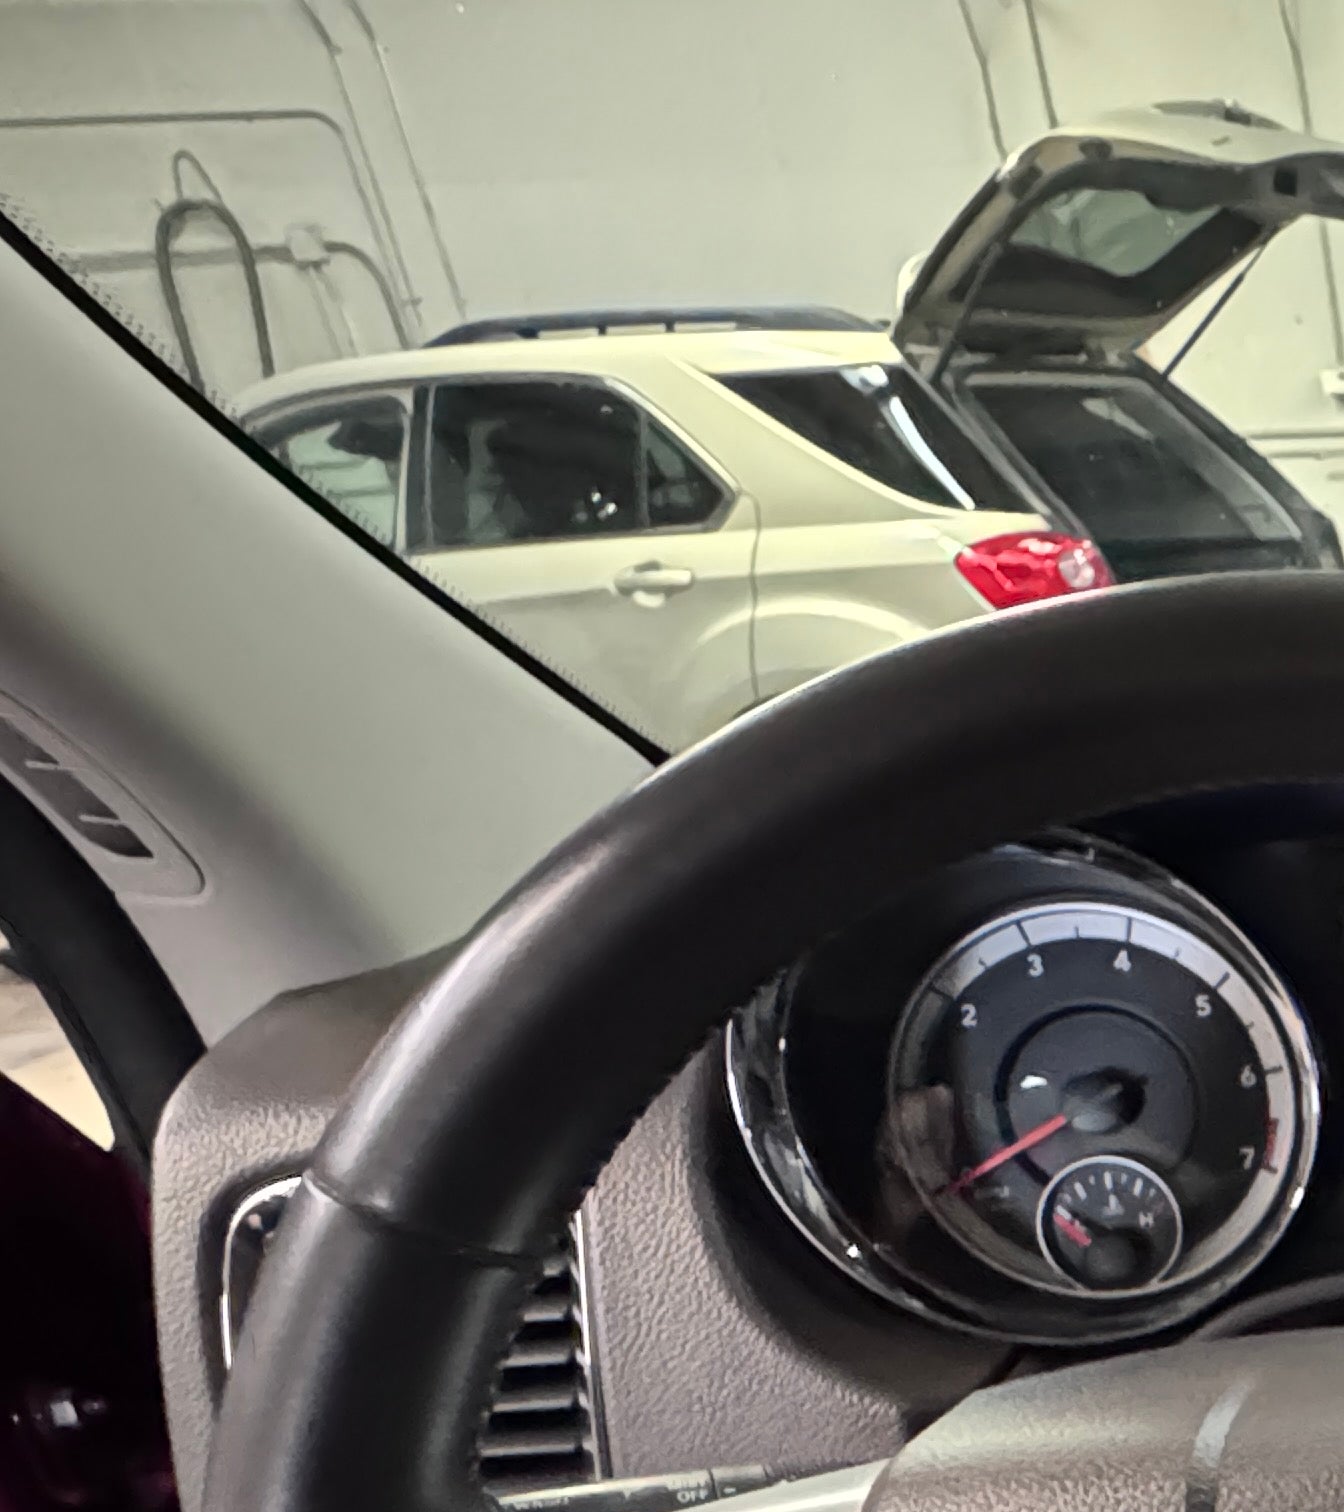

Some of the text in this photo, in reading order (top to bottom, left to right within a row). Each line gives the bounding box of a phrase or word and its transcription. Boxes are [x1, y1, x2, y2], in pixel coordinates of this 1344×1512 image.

[1027, 953, 1044, 976] 3
[1113, 950, 1132, 971] 4
[961, 1005, 978, 1027] 2
[1196, 995, 1212, 1016] 5
[1240, 1066, 1256, 1087] 6
[1240, 1149, 1255, 1168] 7
